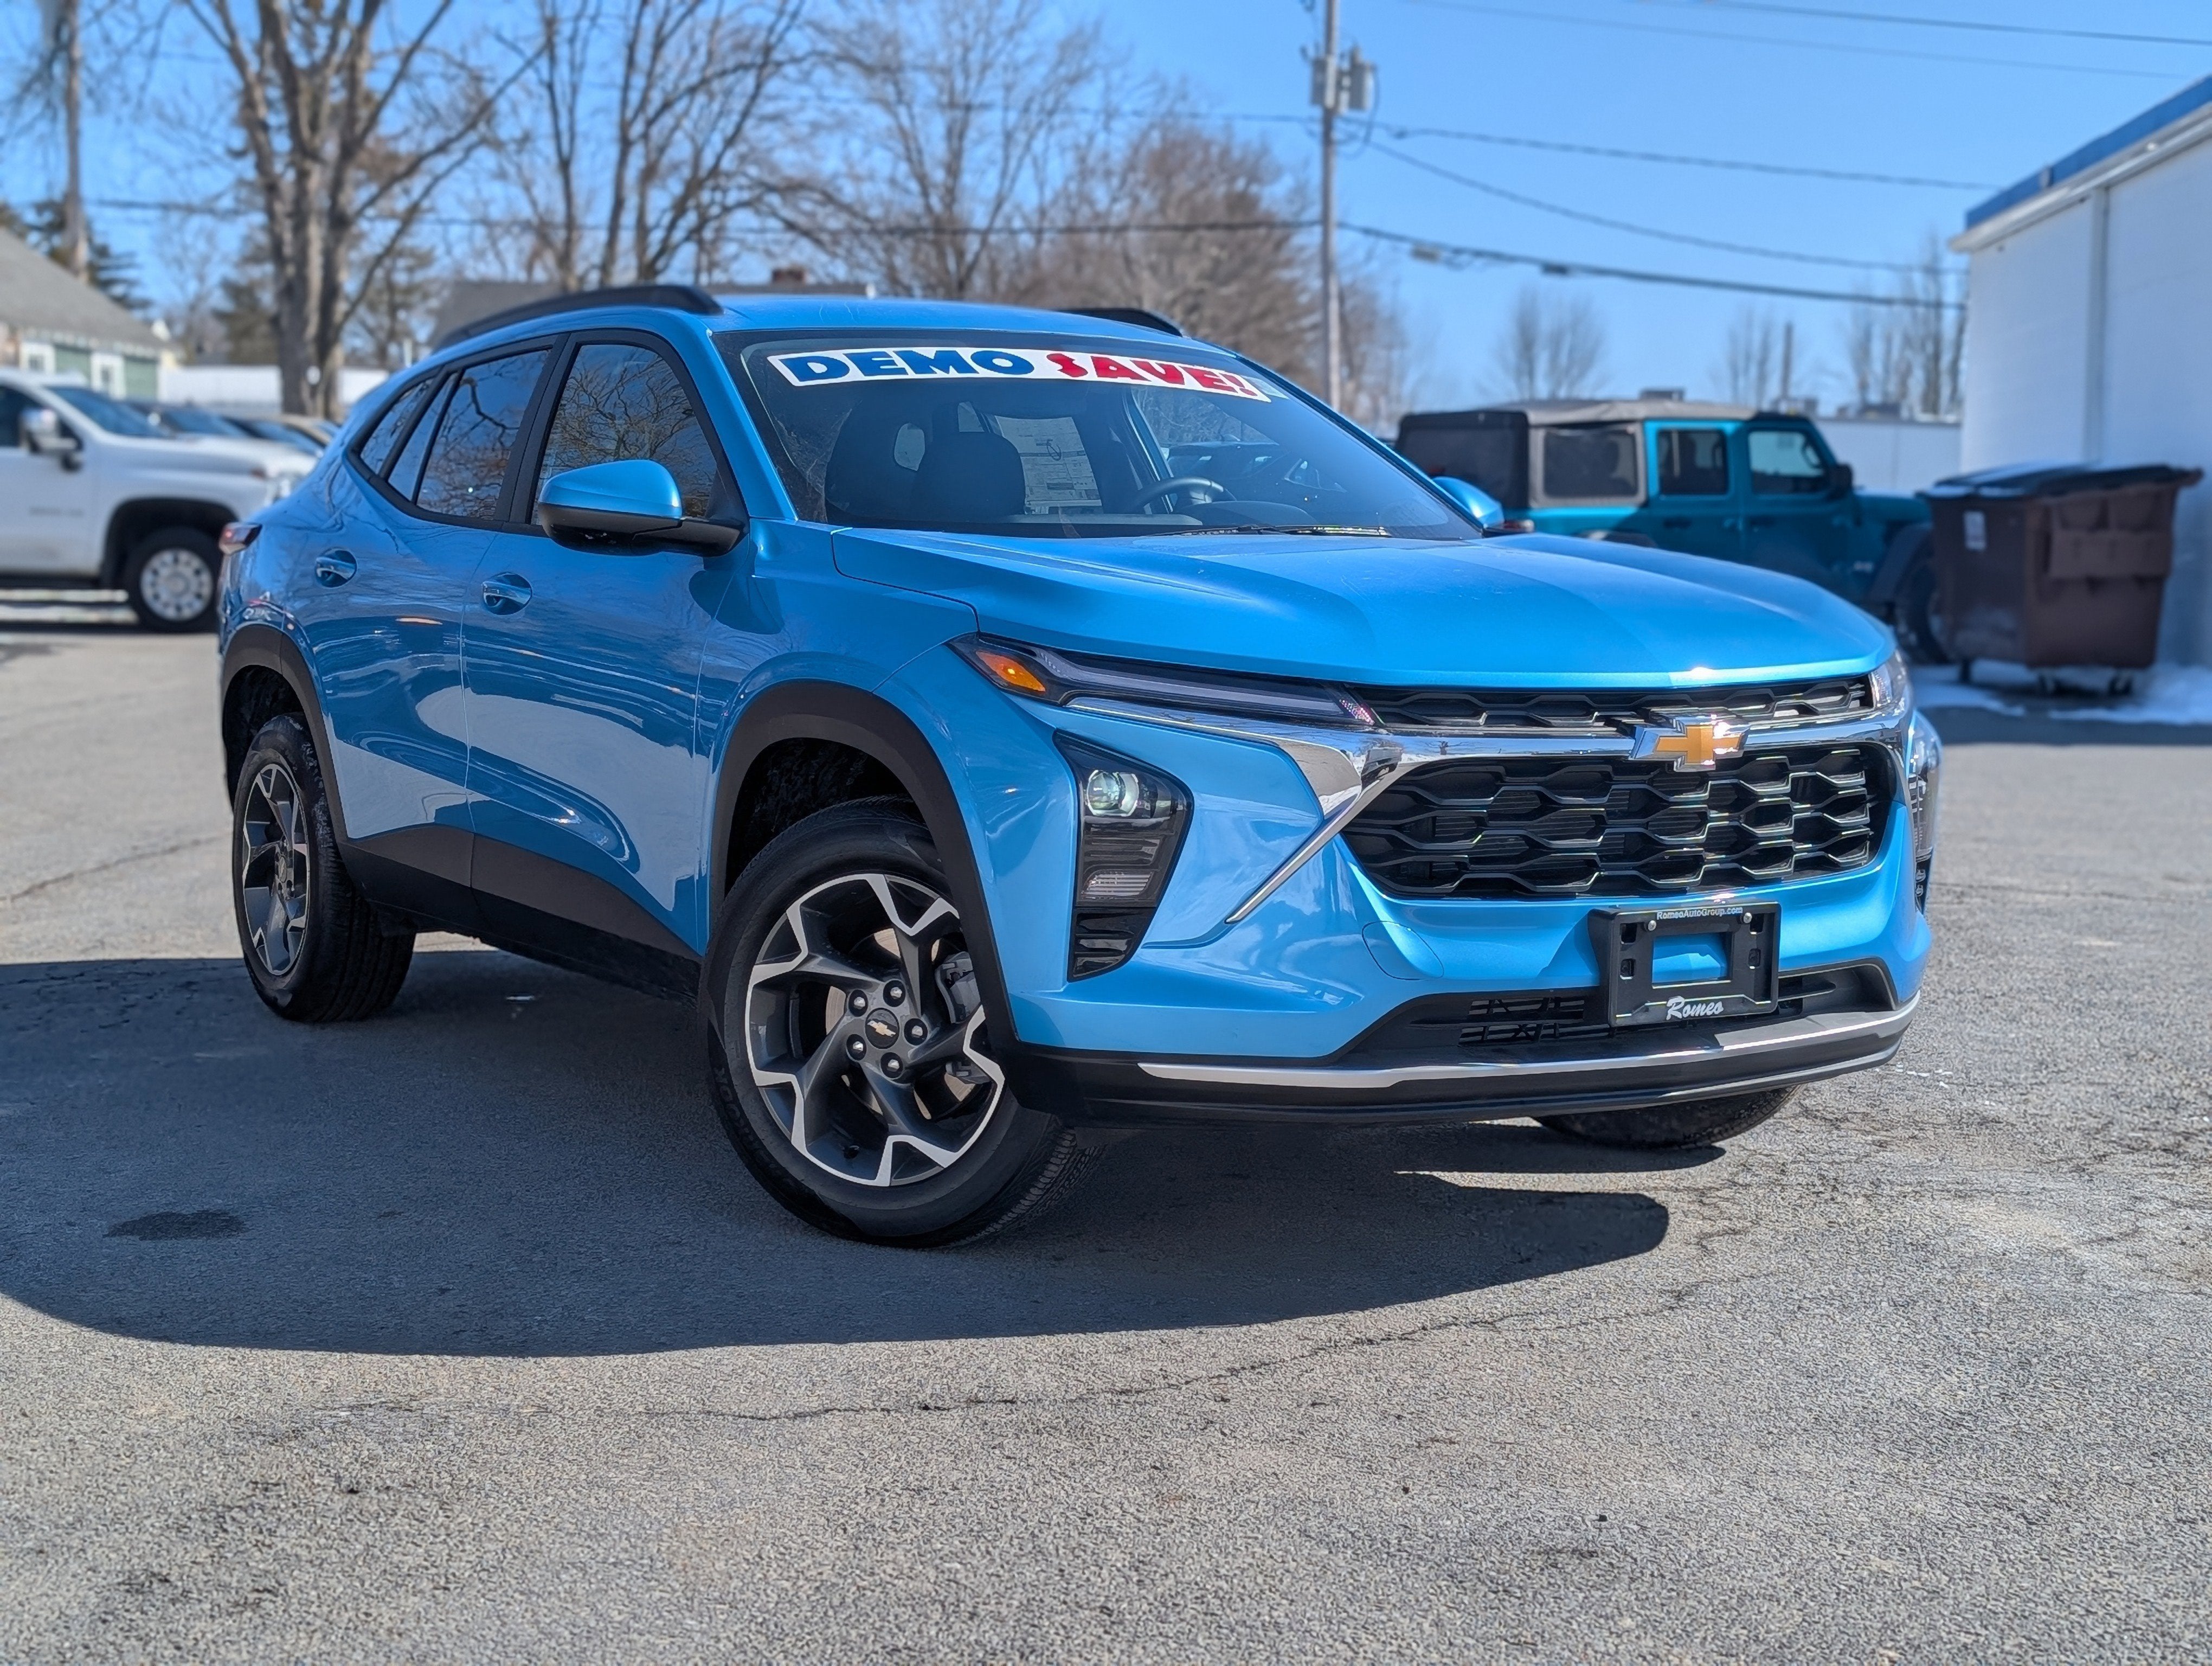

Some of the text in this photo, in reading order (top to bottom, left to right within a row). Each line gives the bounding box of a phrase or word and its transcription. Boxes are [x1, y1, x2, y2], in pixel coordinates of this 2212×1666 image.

[778, 350, 1258, 396] DEMO SAVE!
[1657, 907, 1743, 920] RomeoAutoGroup.com
[1666, 996, 1724, 1020] Romeo
